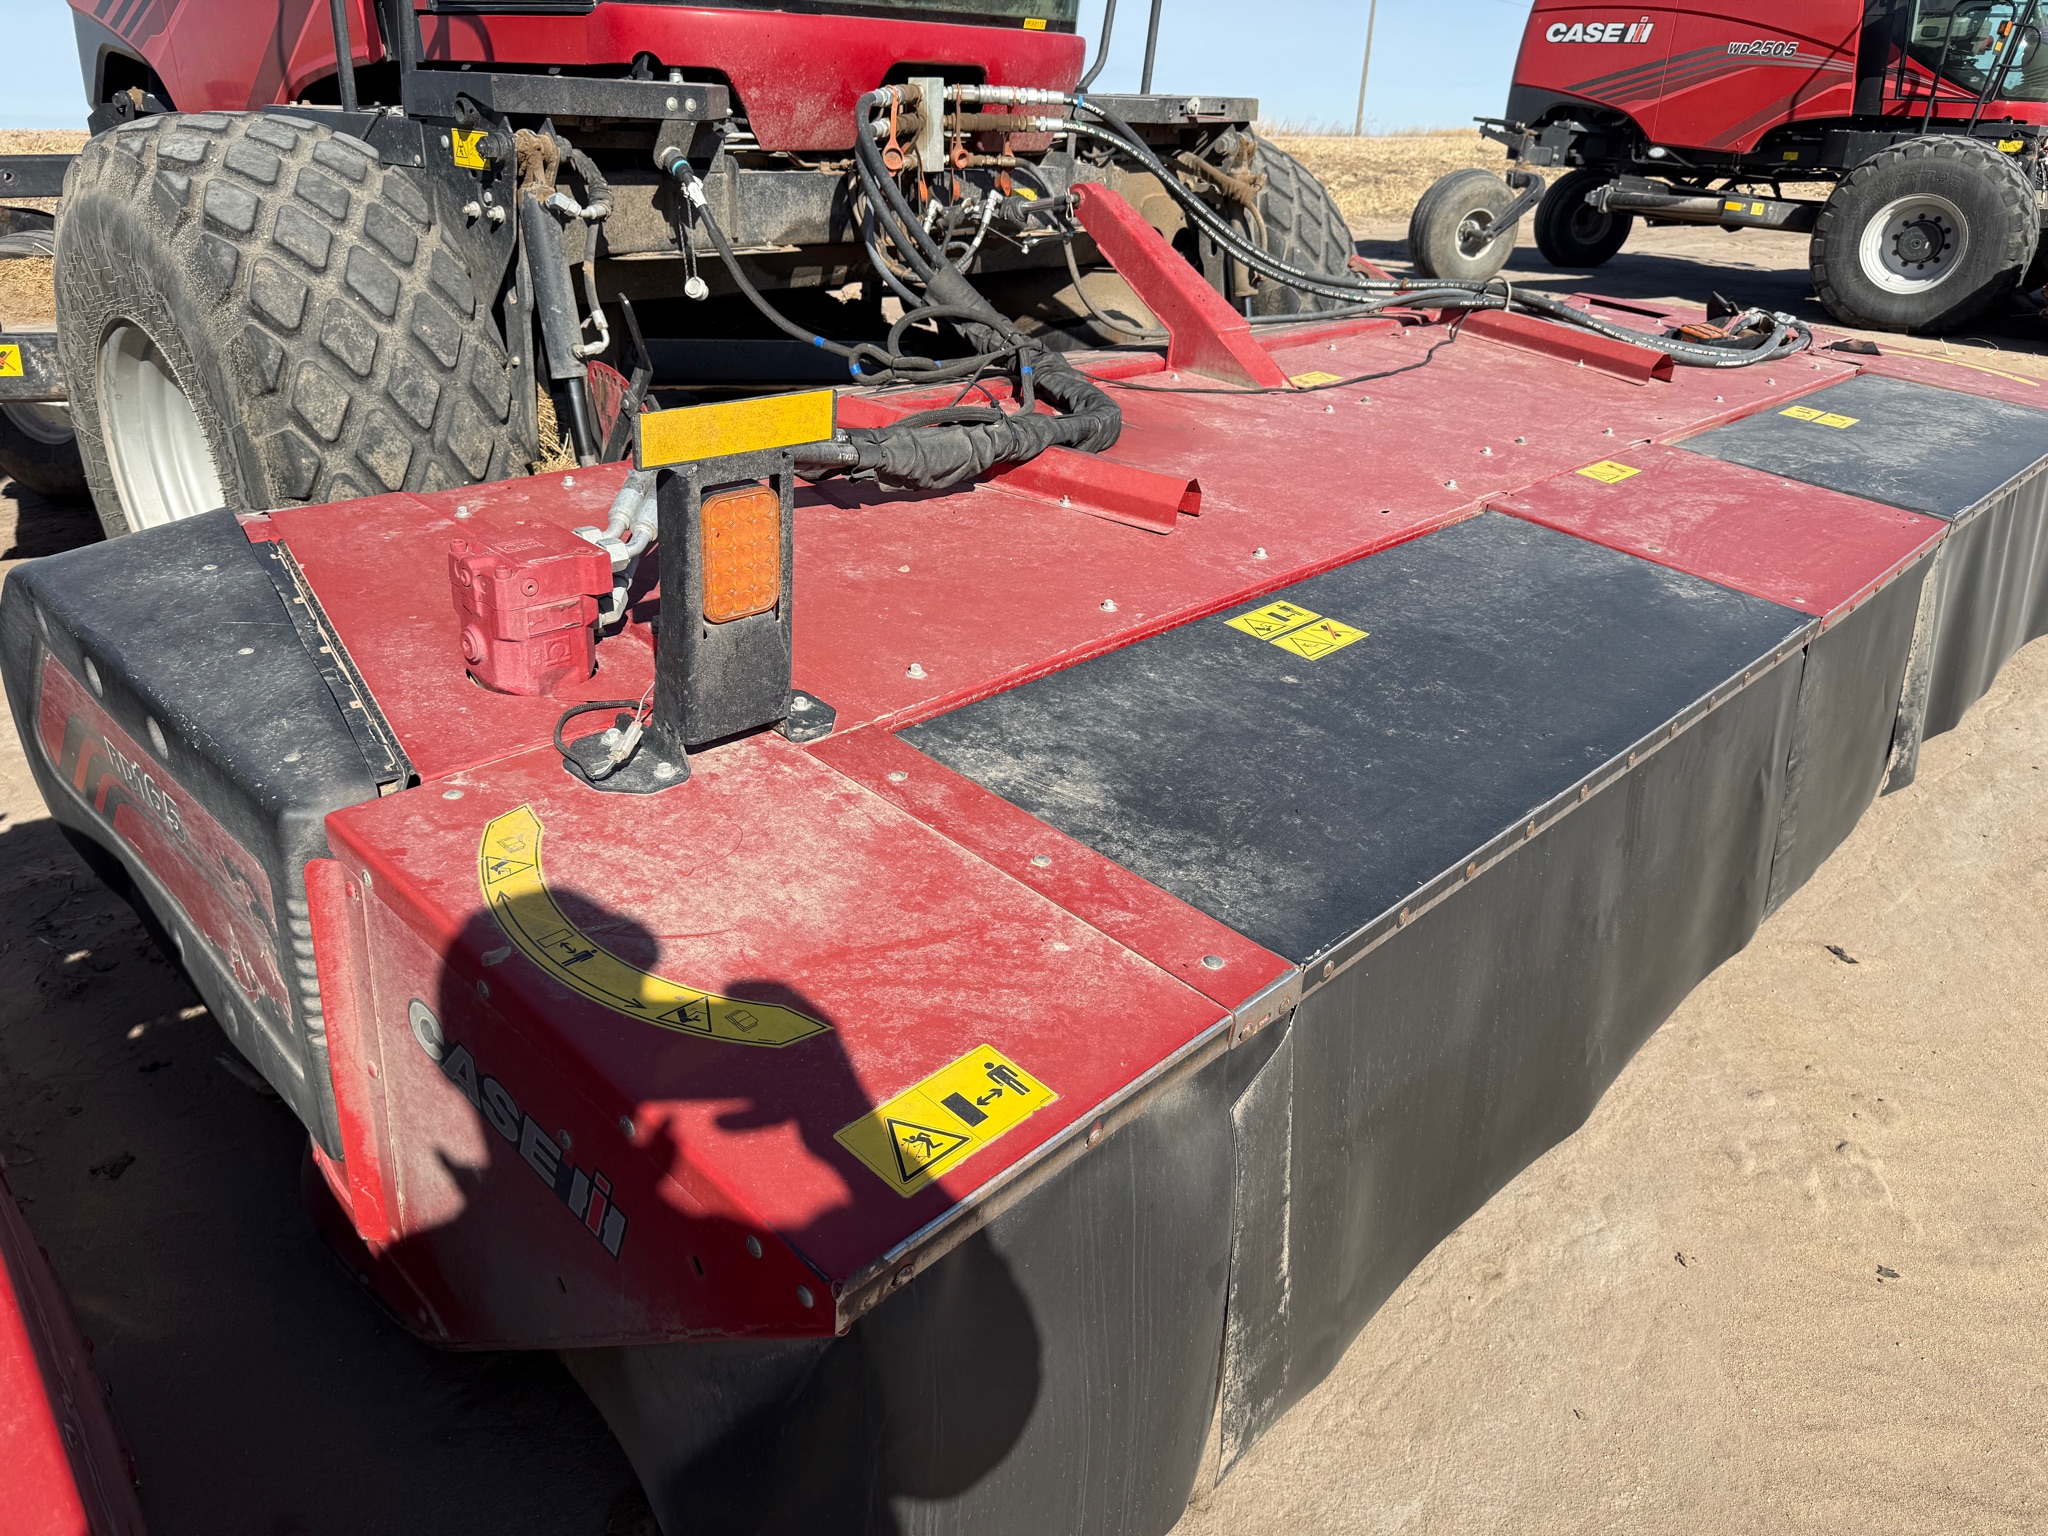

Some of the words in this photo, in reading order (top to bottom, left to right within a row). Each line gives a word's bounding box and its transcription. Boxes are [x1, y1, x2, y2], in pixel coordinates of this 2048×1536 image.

[1545, 22, 1625, 43] CASE
[1727, 40, 1799, 58] WD2505
[408, 997, 564, 1189] CASE
